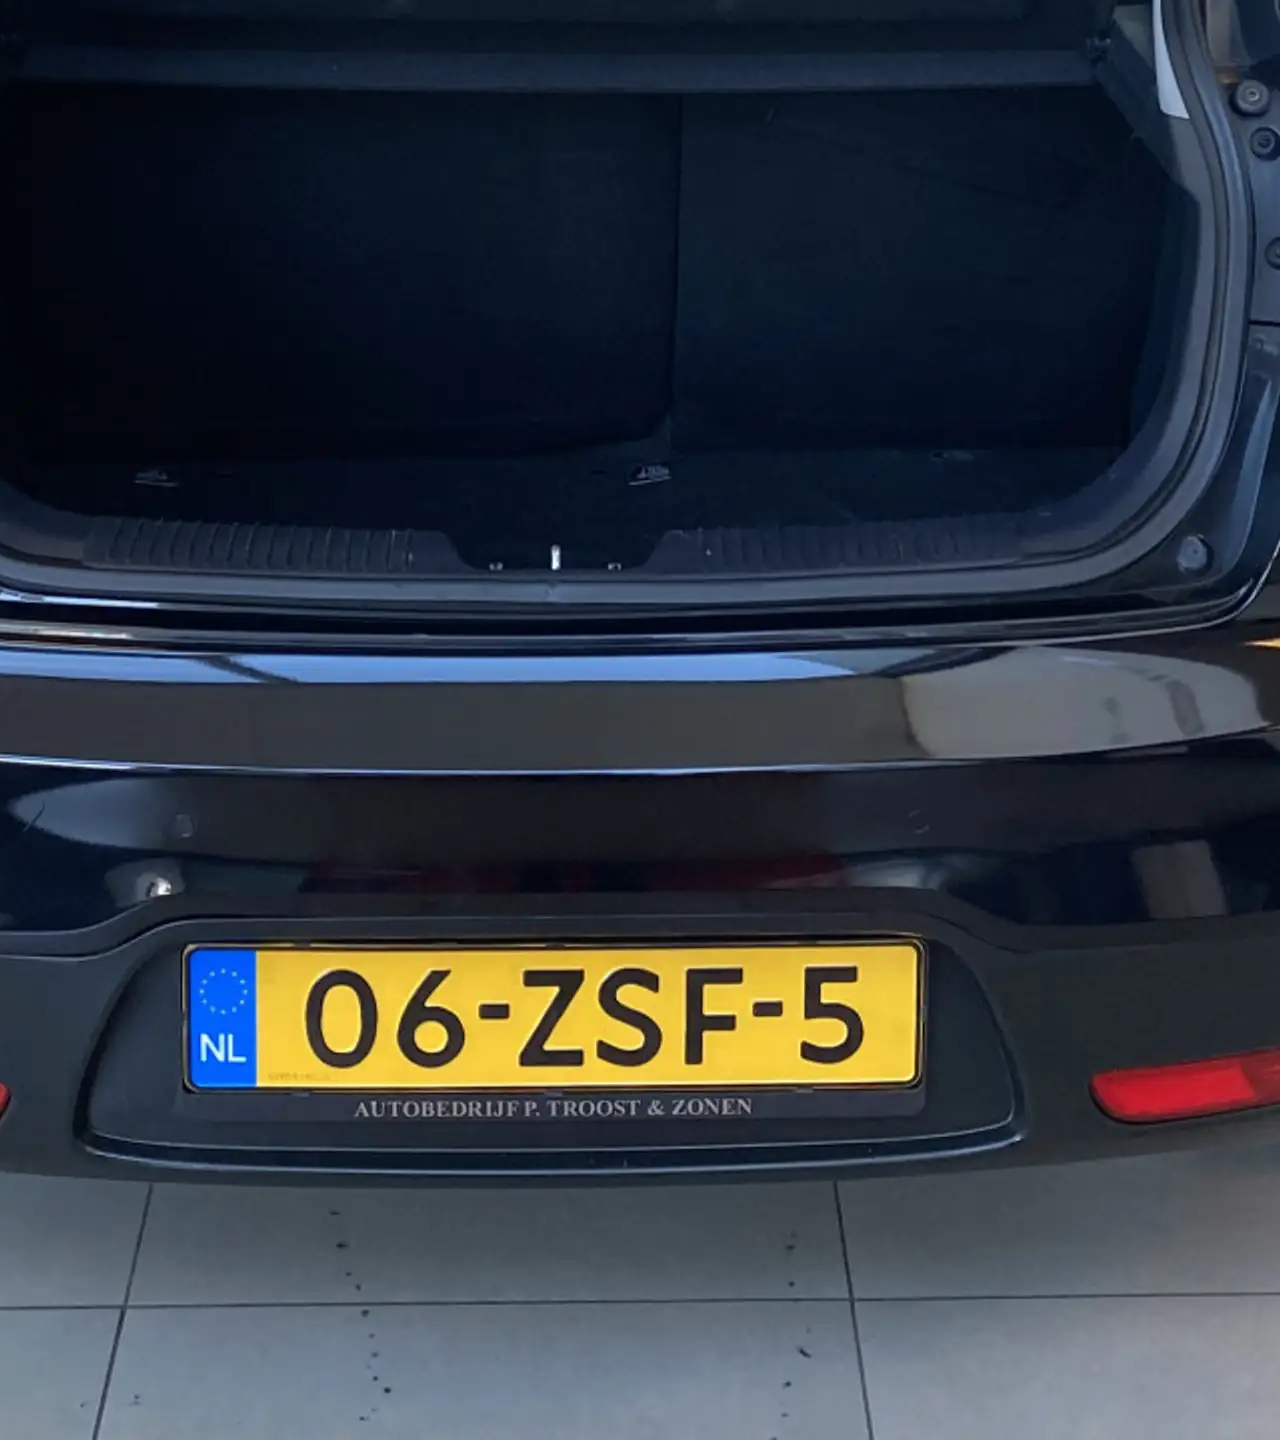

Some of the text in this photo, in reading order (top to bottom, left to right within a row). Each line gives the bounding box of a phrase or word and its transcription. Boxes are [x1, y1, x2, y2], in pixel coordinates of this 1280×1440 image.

[304, 965, 865, 1069] 06-ZSF-5
[199, 1034, 247, 1064] NL
[354, 1097, 753, 1118] AUTOBEDRIJF P. TROOST & ZONEN
